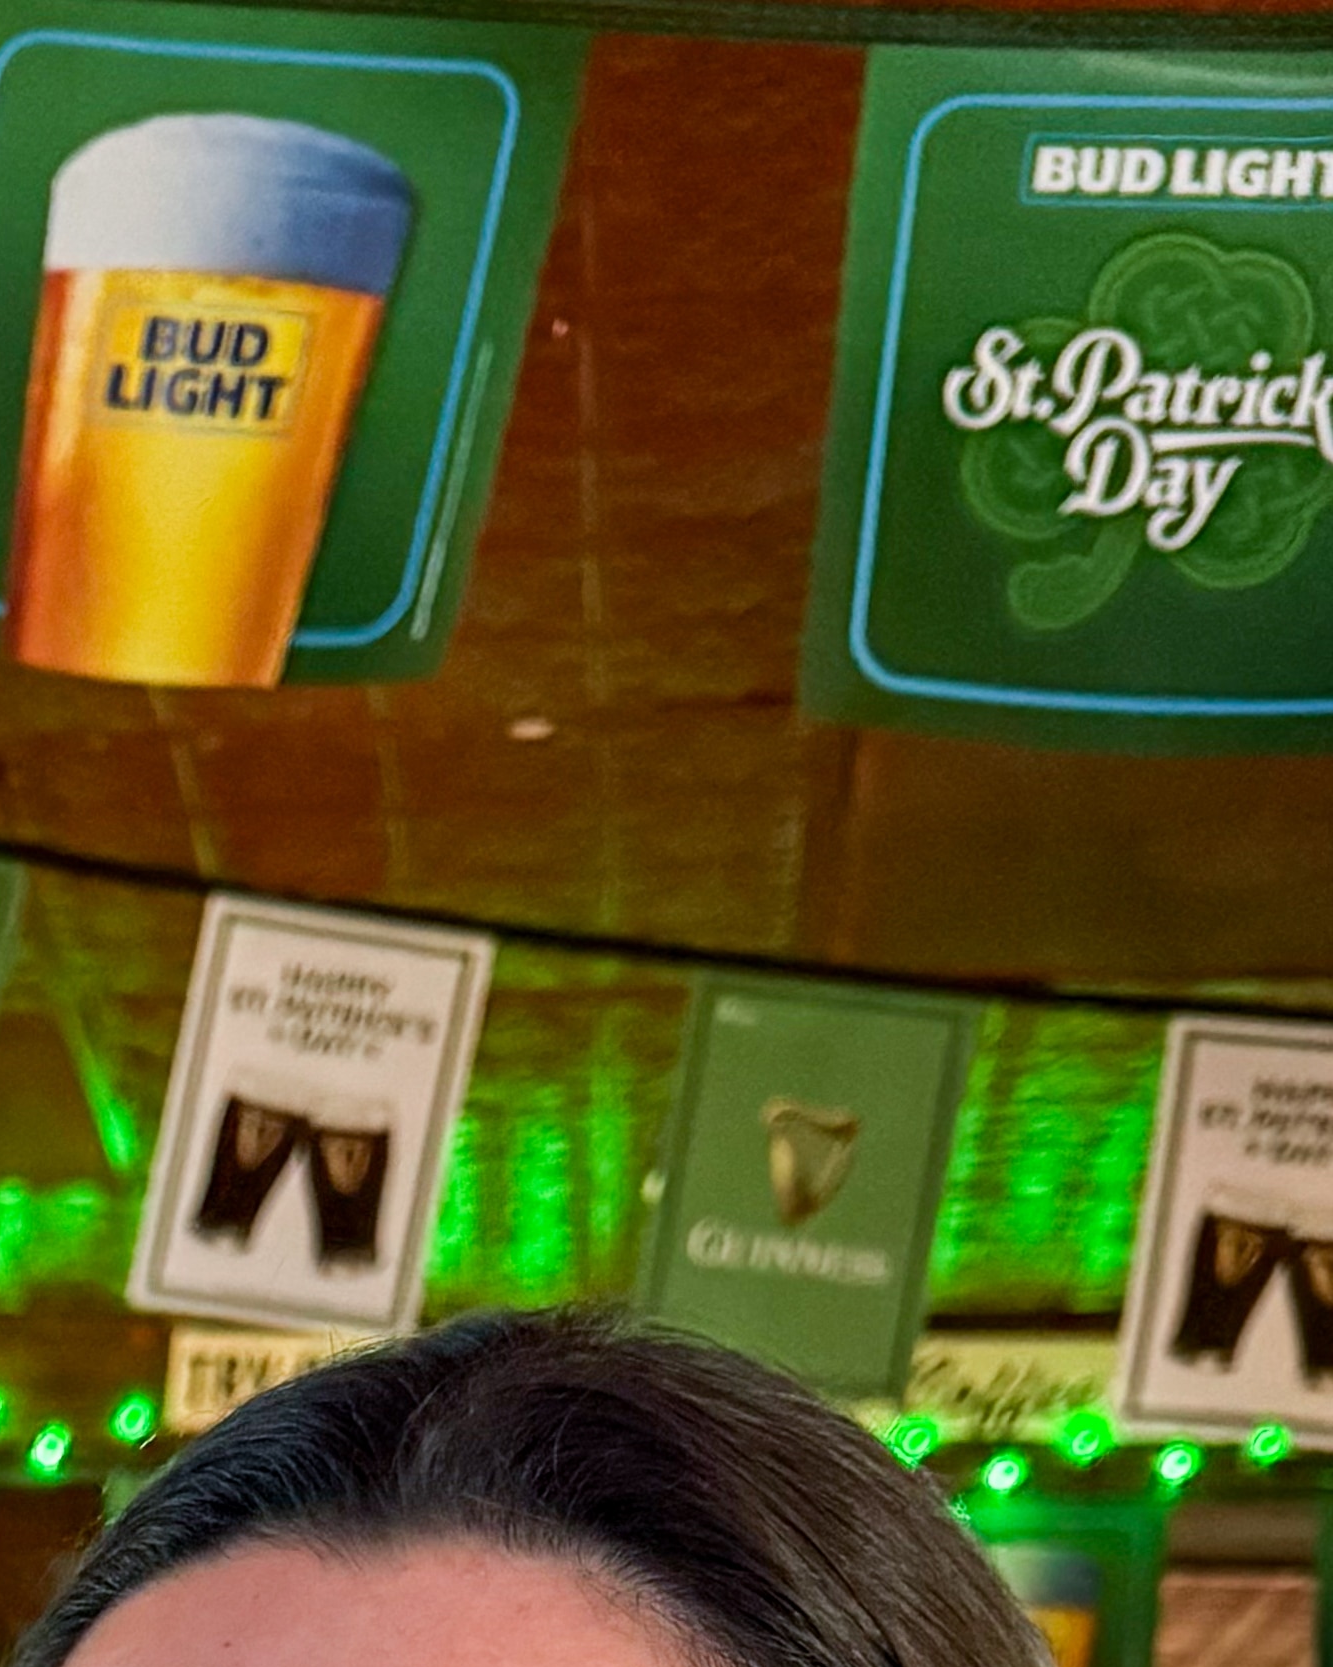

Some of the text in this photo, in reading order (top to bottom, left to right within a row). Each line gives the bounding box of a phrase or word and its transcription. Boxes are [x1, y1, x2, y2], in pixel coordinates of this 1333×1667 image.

[1032, 145, 1167, 195] BUD
[104, 314, 286, 421] BUD LIGHT
[942, 327, 1055, 430] St.
[1056, 416, 1243, 552] Day
